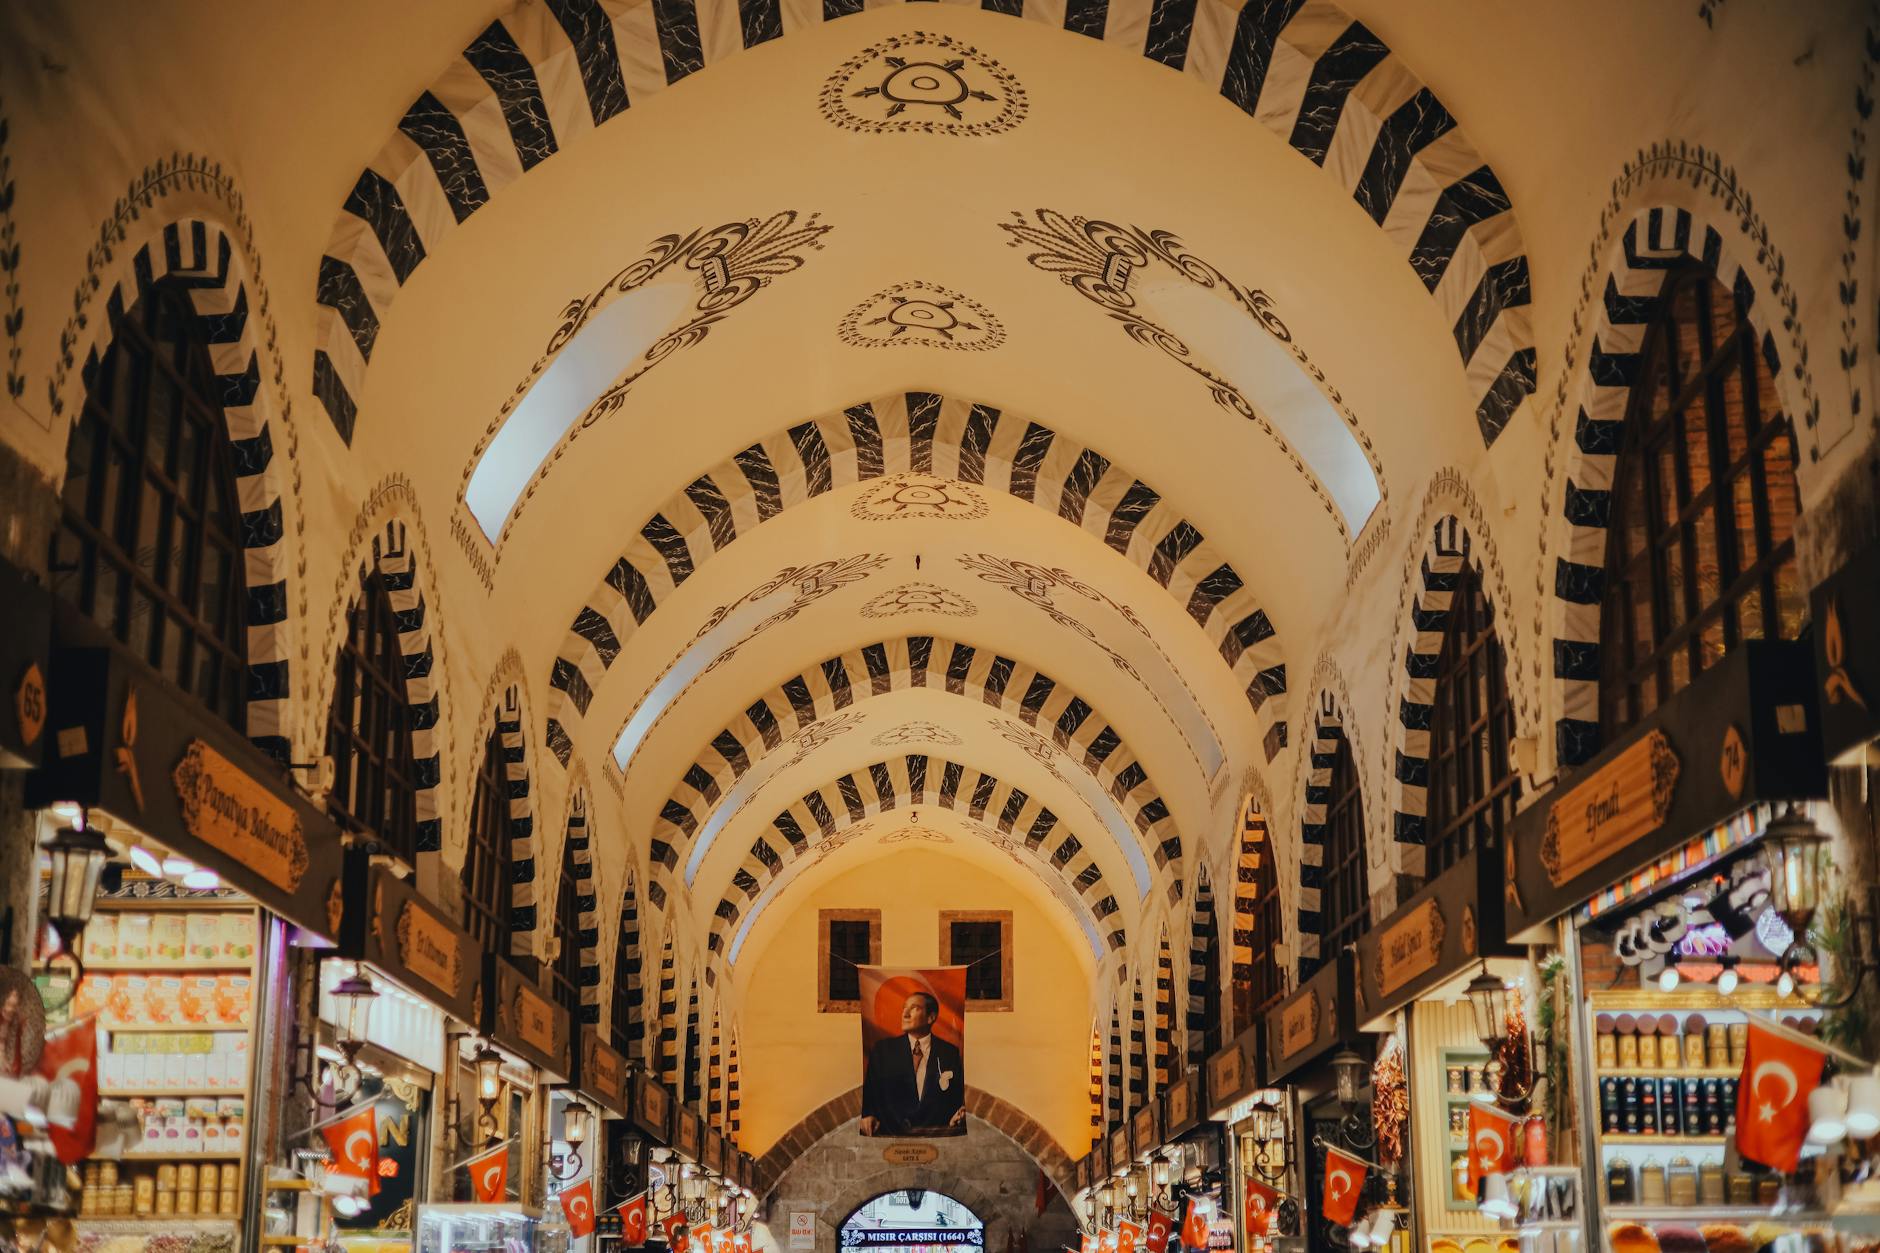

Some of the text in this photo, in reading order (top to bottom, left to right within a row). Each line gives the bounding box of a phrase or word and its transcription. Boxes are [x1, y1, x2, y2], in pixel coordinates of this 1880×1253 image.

[23, 682, 41, 723] 65
[1725, 741, 1741, 780] 74
[202, 774, 289, 858] Papatya Baharat
[1585, 780, 1620, 843] Efendi
[867, 1232, 966, 1243] MISIR ÇARŞISI (1664)
